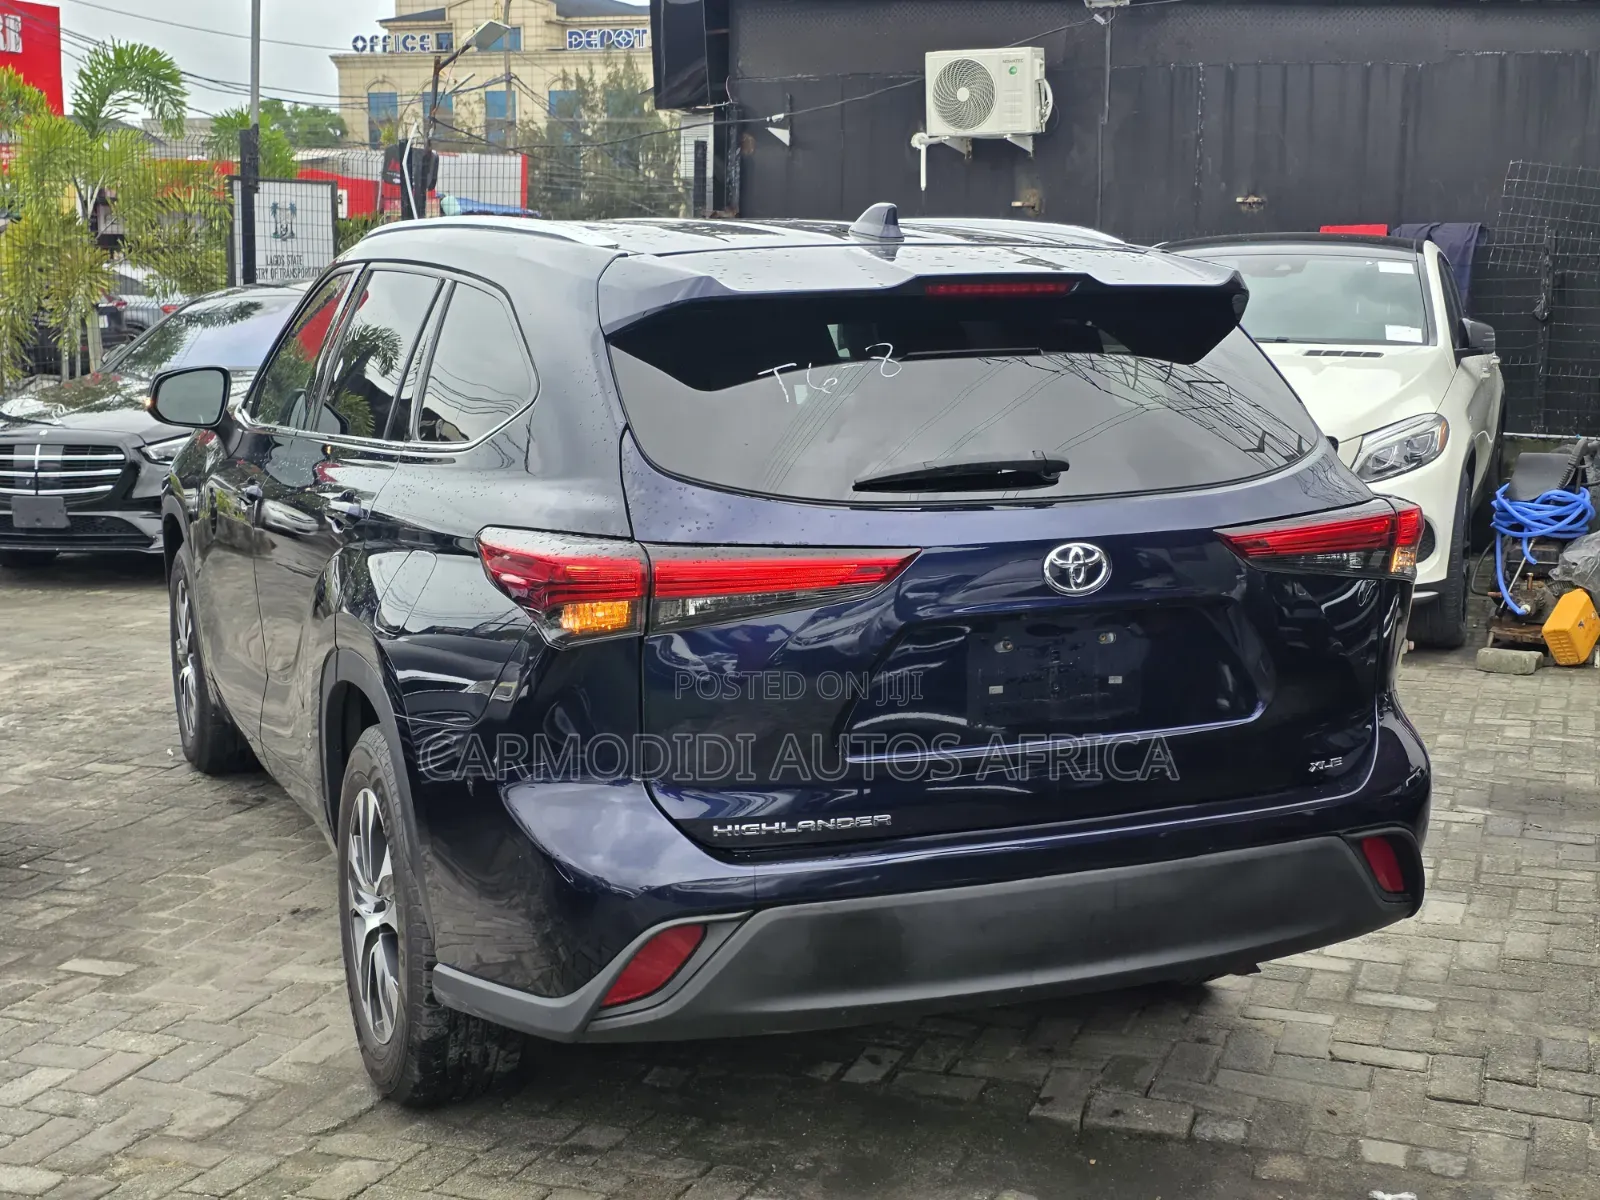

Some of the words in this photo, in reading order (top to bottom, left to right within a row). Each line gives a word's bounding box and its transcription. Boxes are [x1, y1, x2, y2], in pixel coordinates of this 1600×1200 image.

[352, 33, 431, 53] OFFICE
[567, 28, 648, 50] DEPOT
[266, 254, 285, 266] LAGOS
[287, 254, 303, 265] STATE
[255, 267, 268, 280] STRY
[1308, 756, 1343, 772] XLE
[712, 814, 892, 837] HIGHLANDER
